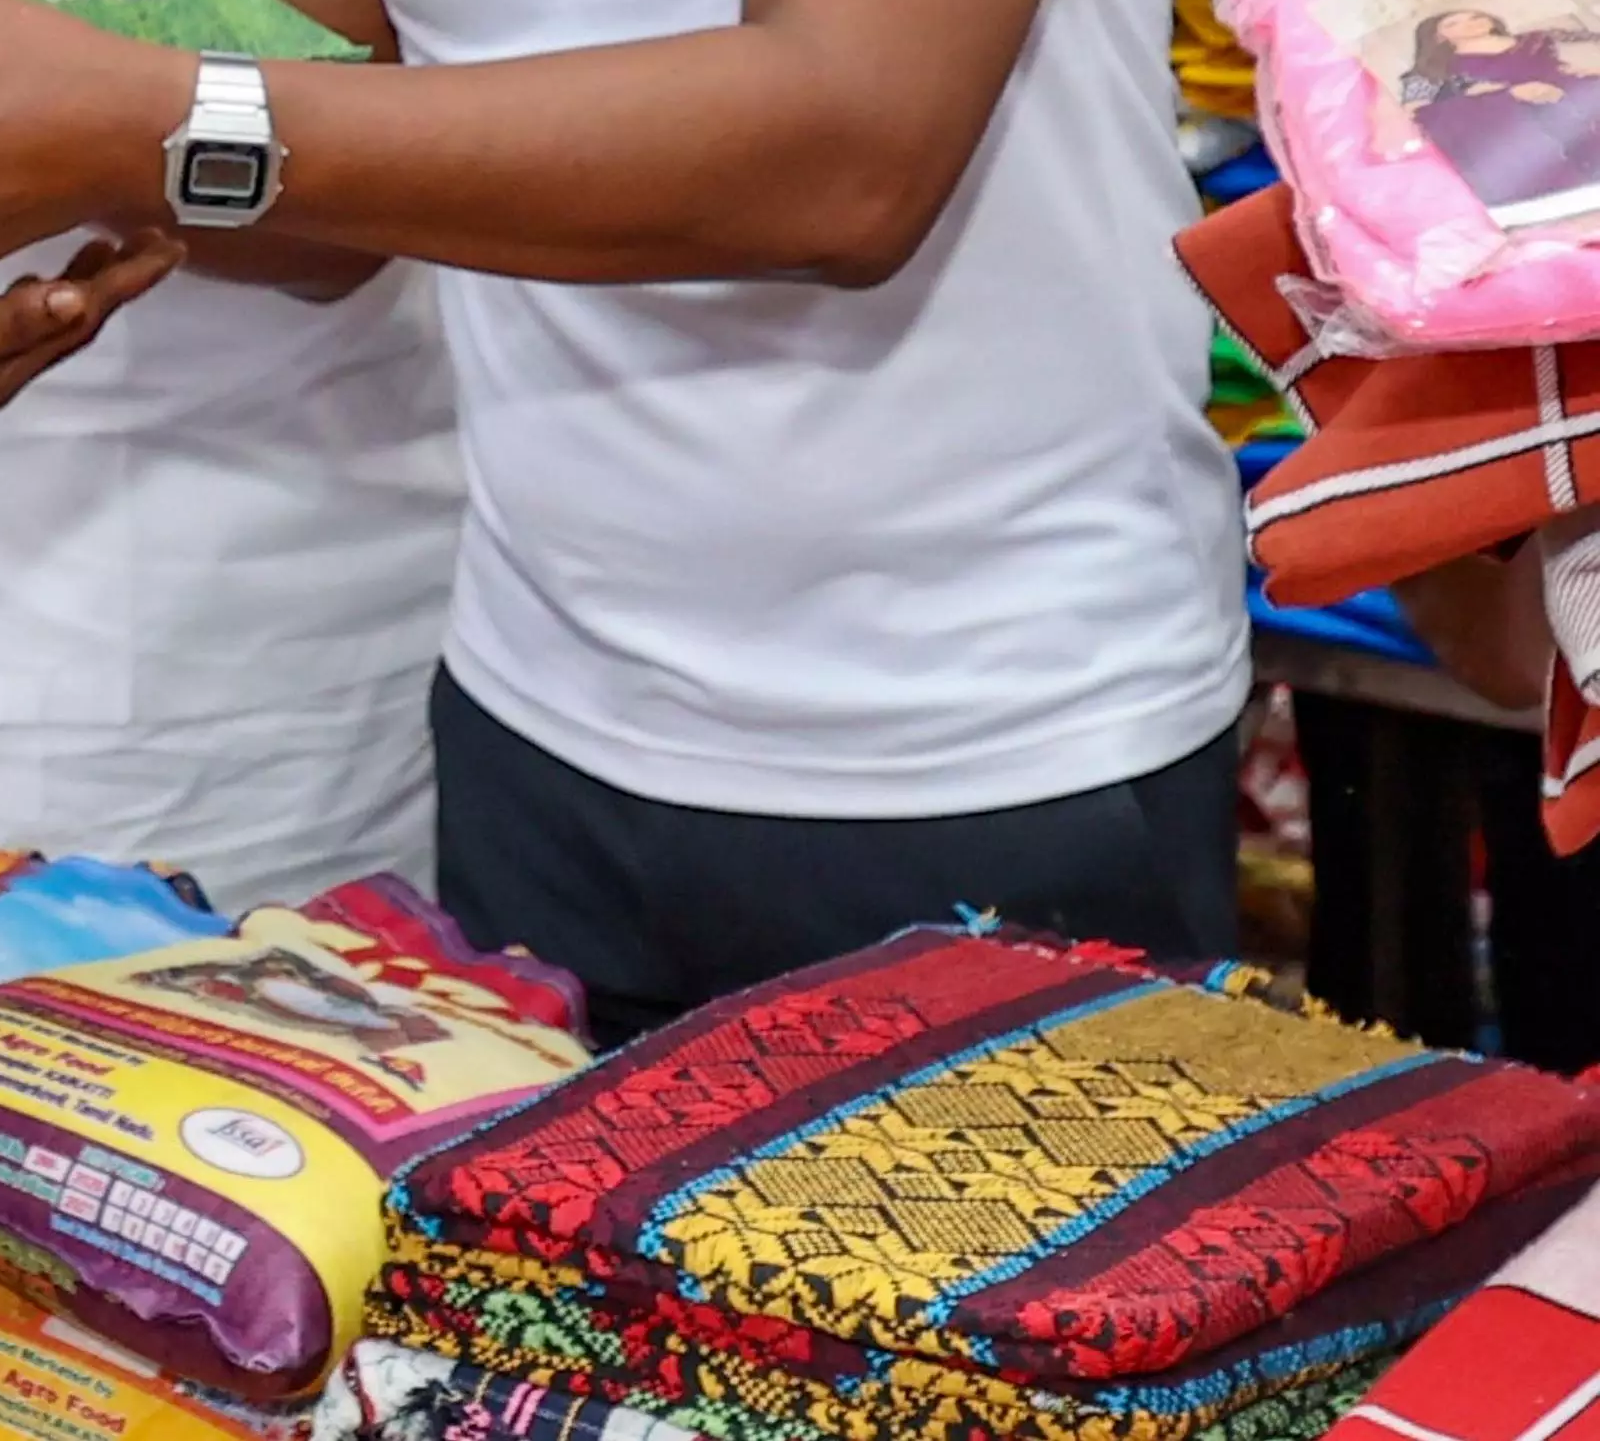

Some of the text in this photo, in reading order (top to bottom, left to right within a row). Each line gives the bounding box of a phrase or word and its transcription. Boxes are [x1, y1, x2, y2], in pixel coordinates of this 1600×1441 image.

[54, 1049, 117, 1077] Food
[18, 1346, 93, 1387] Marketed
[2, 1367, 60, 1405] Agro
[64, 1393, 129, 1435] Food
